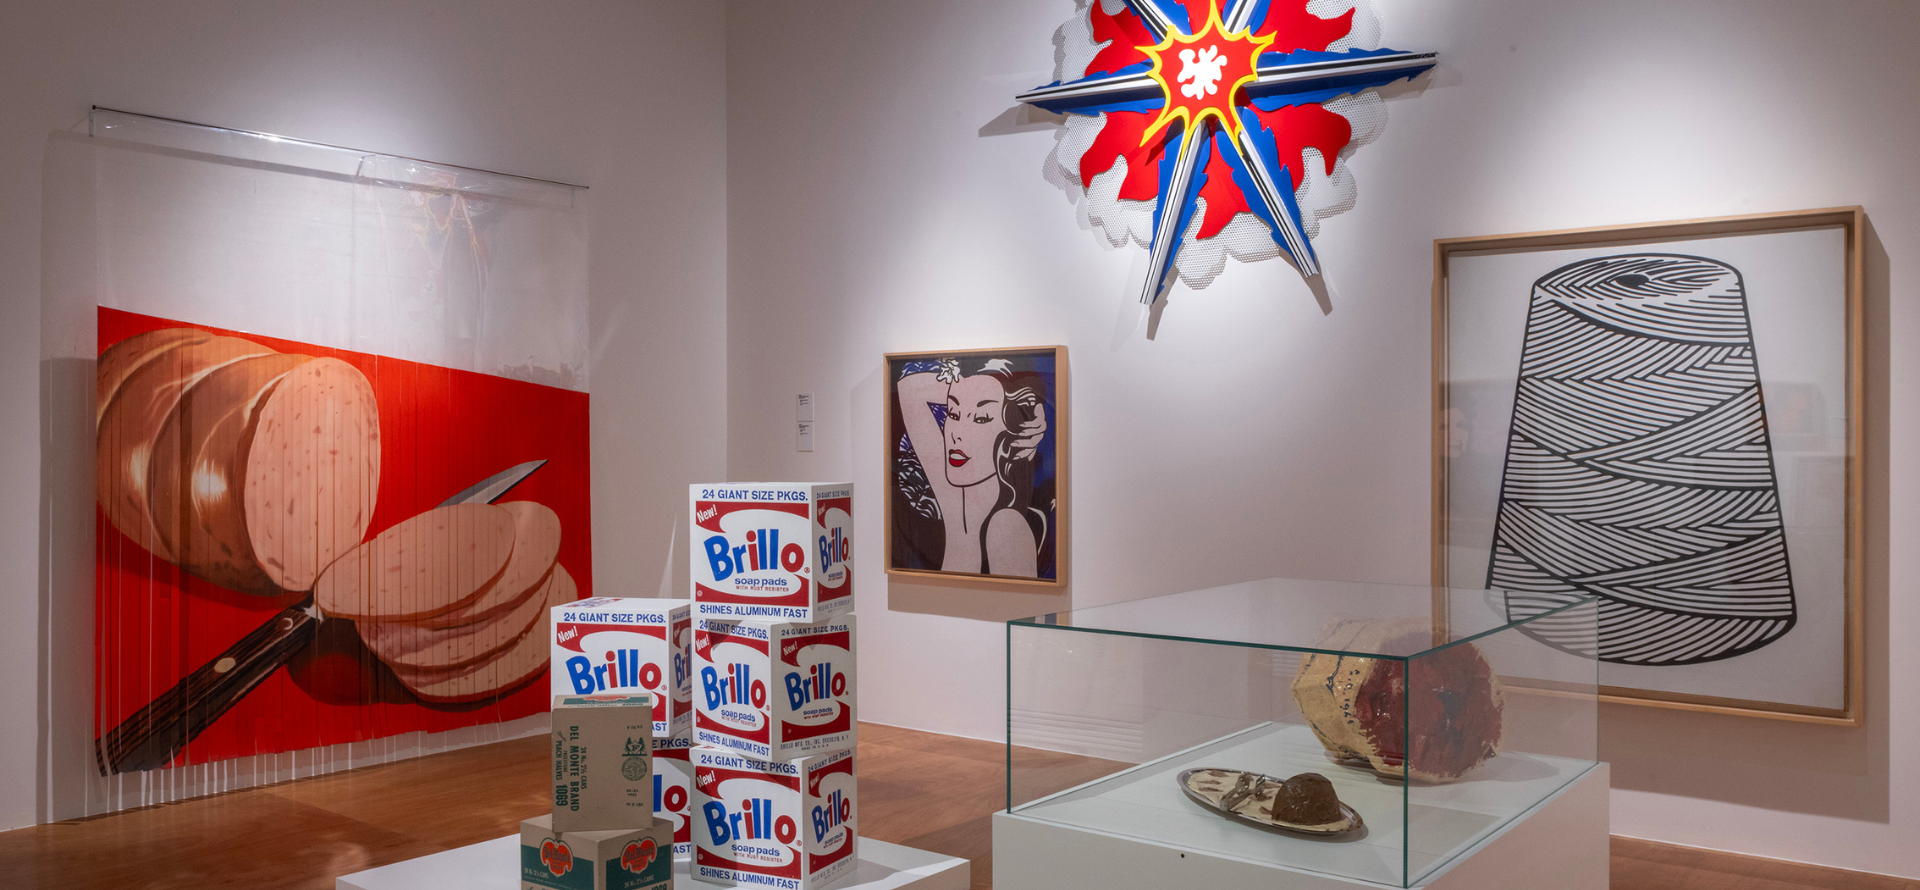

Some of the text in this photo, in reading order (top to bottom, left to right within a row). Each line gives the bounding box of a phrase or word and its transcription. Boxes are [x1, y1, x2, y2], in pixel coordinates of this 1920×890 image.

[702, 489, 808, 501] 24 GIANT SIZE PKGS.
[697, 504, 718, 523] New!
[703, 528, 805, 582] Brillo
[818, 527, 849, 574] Brillo
[735, 577, 787, 586] soap pads
[564, 612, 666, 623] 24 GIANT SIZE PKGS.
[700, 604, 808, 618] SHINES ALUMINUM FAST
[557, 625, 578, 643] New!
[700, 620, 769, 639] 24 GIANT SIZE PKGS.
[791, 627, 811, 635] GIANT
[695, 635, 710, 651] New!
[783, 641, 798, 656] New!
[565, 649, 662, 695] Brillo
[700, 663, 767, 711] Brillo
[784, 662, 846, 712] Brillo
[721, 709, 756, 723] soap pads
[660, 738, 692, 748] PKGS.
[699, 732, 770, 757] SHINES ALUMINUM FAST
[570, 726, 580, 812] DEL MONTE BRAND
[701, 754, 799, 775] 24 GIANT SIZE PKGS.
[697, 770, 716, 788] New!
[555, 784, 568, 807] 1069
[702, 798, 797, 847] Brillo
[811, 789, 850, 844] Brillo
[731, 844, 780, 857] soap pads
[700, 867, 799, 890] SHINES ALUMINUM FAST
